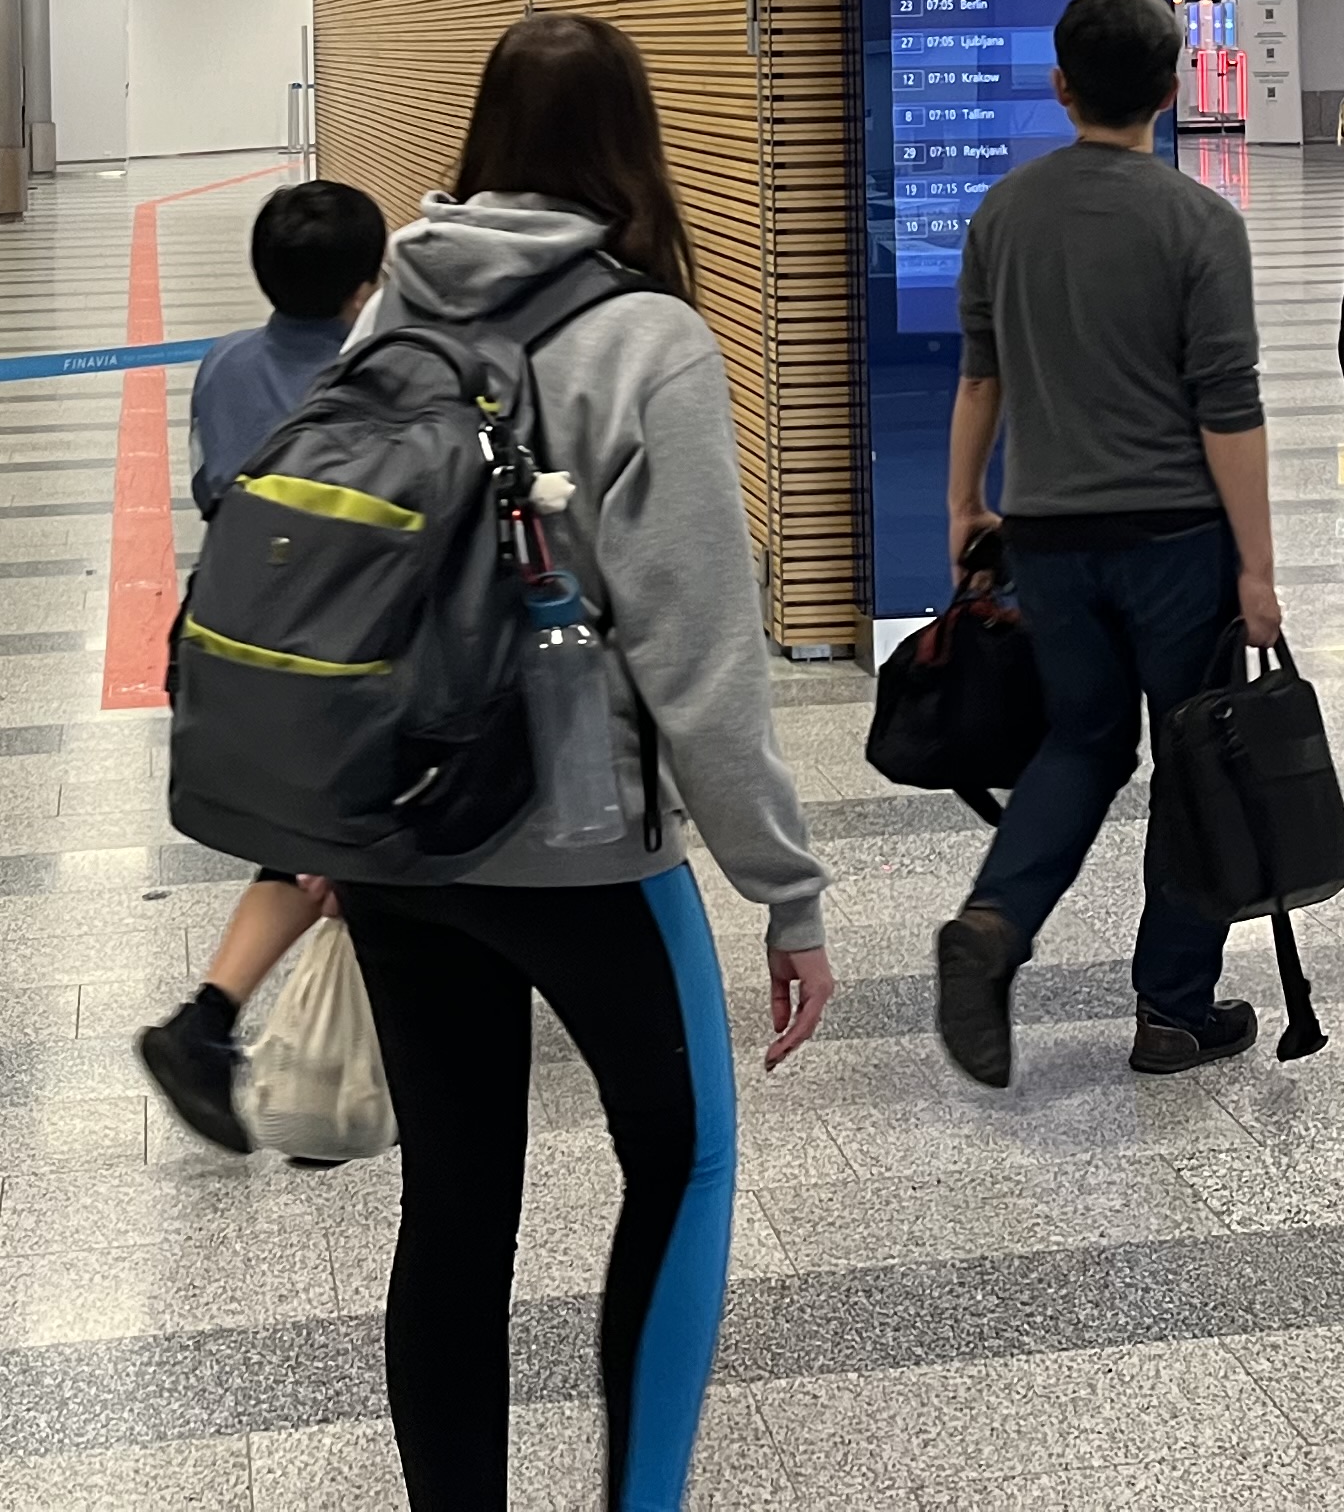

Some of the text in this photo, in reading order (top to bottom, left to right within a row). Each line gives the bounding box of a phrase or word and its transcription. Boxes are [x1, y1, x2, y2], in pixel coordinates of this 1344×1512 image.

[900, 0, 913, 11] 23
[926, 0, 954, 10] 07:05
[901, 35, 1005, 49] 27 07:05 Ljubljana
[903, 71, 1000, 85] 12 07:10 Krakow
[905, 108, 995, 122] 8 07:10 Tallinn
[903, 144, 1008, 159] 29 07:10 Reykjavik
[905, 182, 991, 195] 19 07:15 Goth
[906, 221, 918, 232] 10
[931, 220, 959, 231] 07:15
[63, 354, 118, 371] FINAVIA
